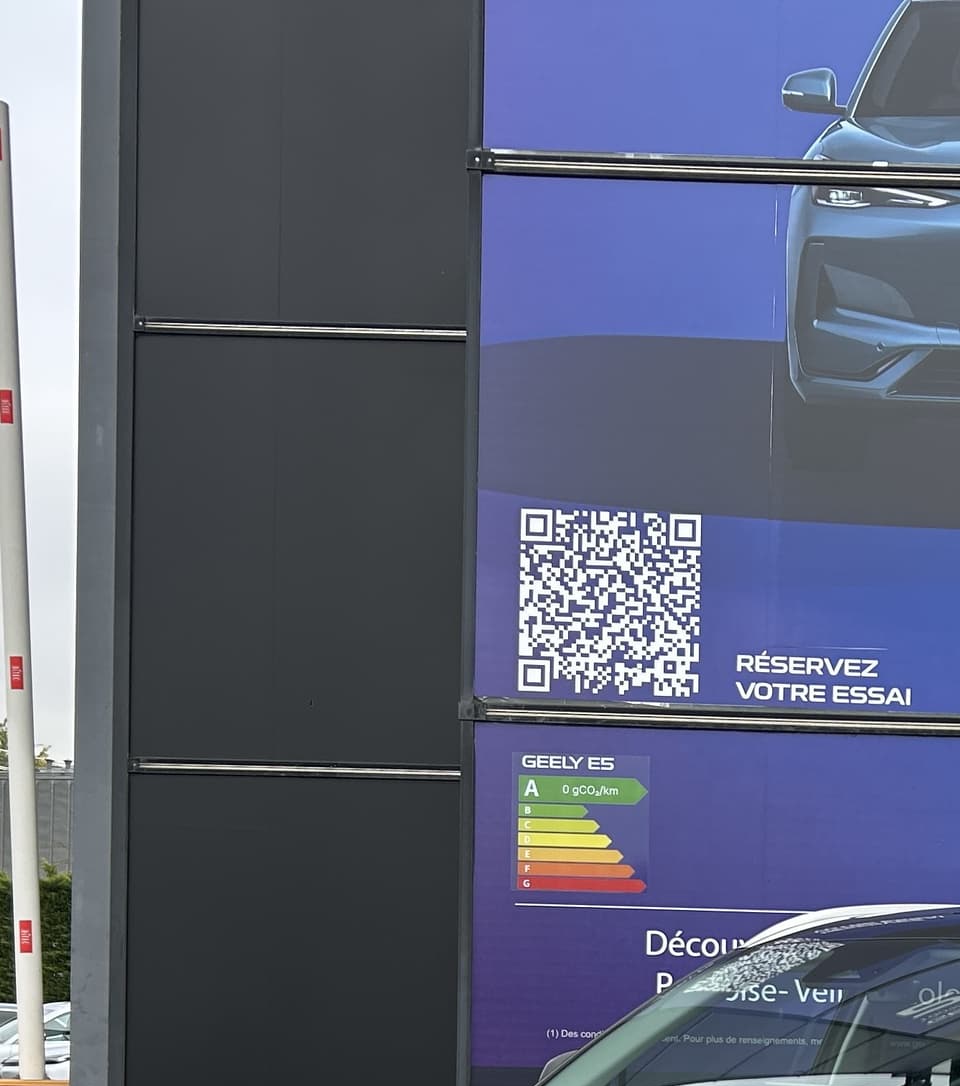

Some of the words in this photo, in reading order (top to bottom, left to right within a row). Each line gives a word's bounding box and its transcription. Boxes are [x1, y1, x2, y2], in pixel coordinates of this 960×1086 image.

[736, 650, 879, 678] RÉSERVEZ
[735, 681, 827, 703] VOTRE
[832, 685, 912, 706] ESSAI
[522, 755, 584, 770] GEELY
[587, 756, 615, 771] E5
[524, 779, 540, 797] A
[562, 784, 570, 794] 0
[524, 806, 532, 815] B
[524, 820, 532, 829] C
[524, 835, 531, 844] D
[524, 850, 531, 859] E
[524, 864, 531, 873] F
[522, 879, 531, 888] G
[546, 1029, 560, 1040] (1)
[561, 1029, 579, 1039] Des
[683, 1034, 704, 1044] Pour
[706, 1034, 724, 1046] plus
